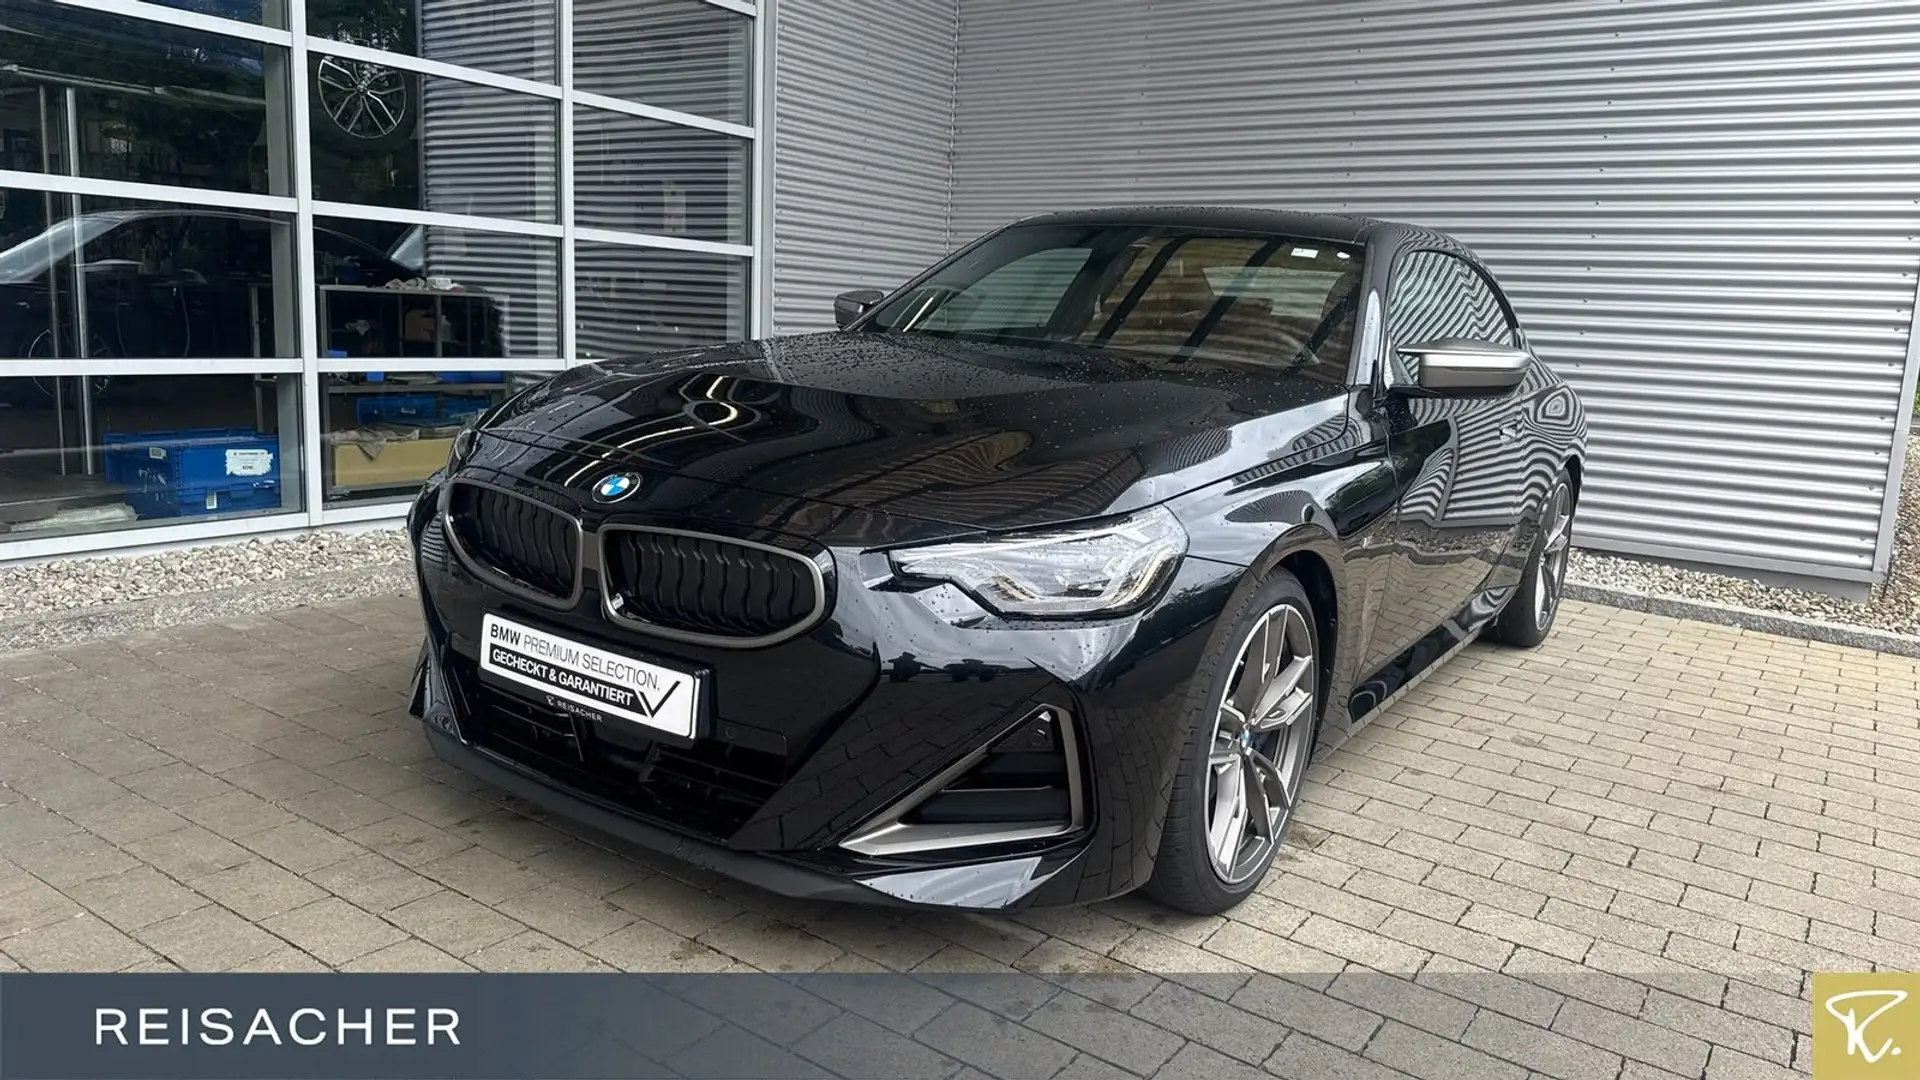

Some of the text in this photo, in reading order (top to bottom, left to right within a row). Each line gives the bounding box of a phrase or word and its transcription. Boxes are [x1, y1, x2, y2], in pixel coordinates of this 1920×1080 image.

[490, 623, 660, 691] BMW PREMIUM SELECTION.
[492, 648, 634, 706] GECHECKT & GARANTIERT
[556, 701, 603, 722] REISACHER
